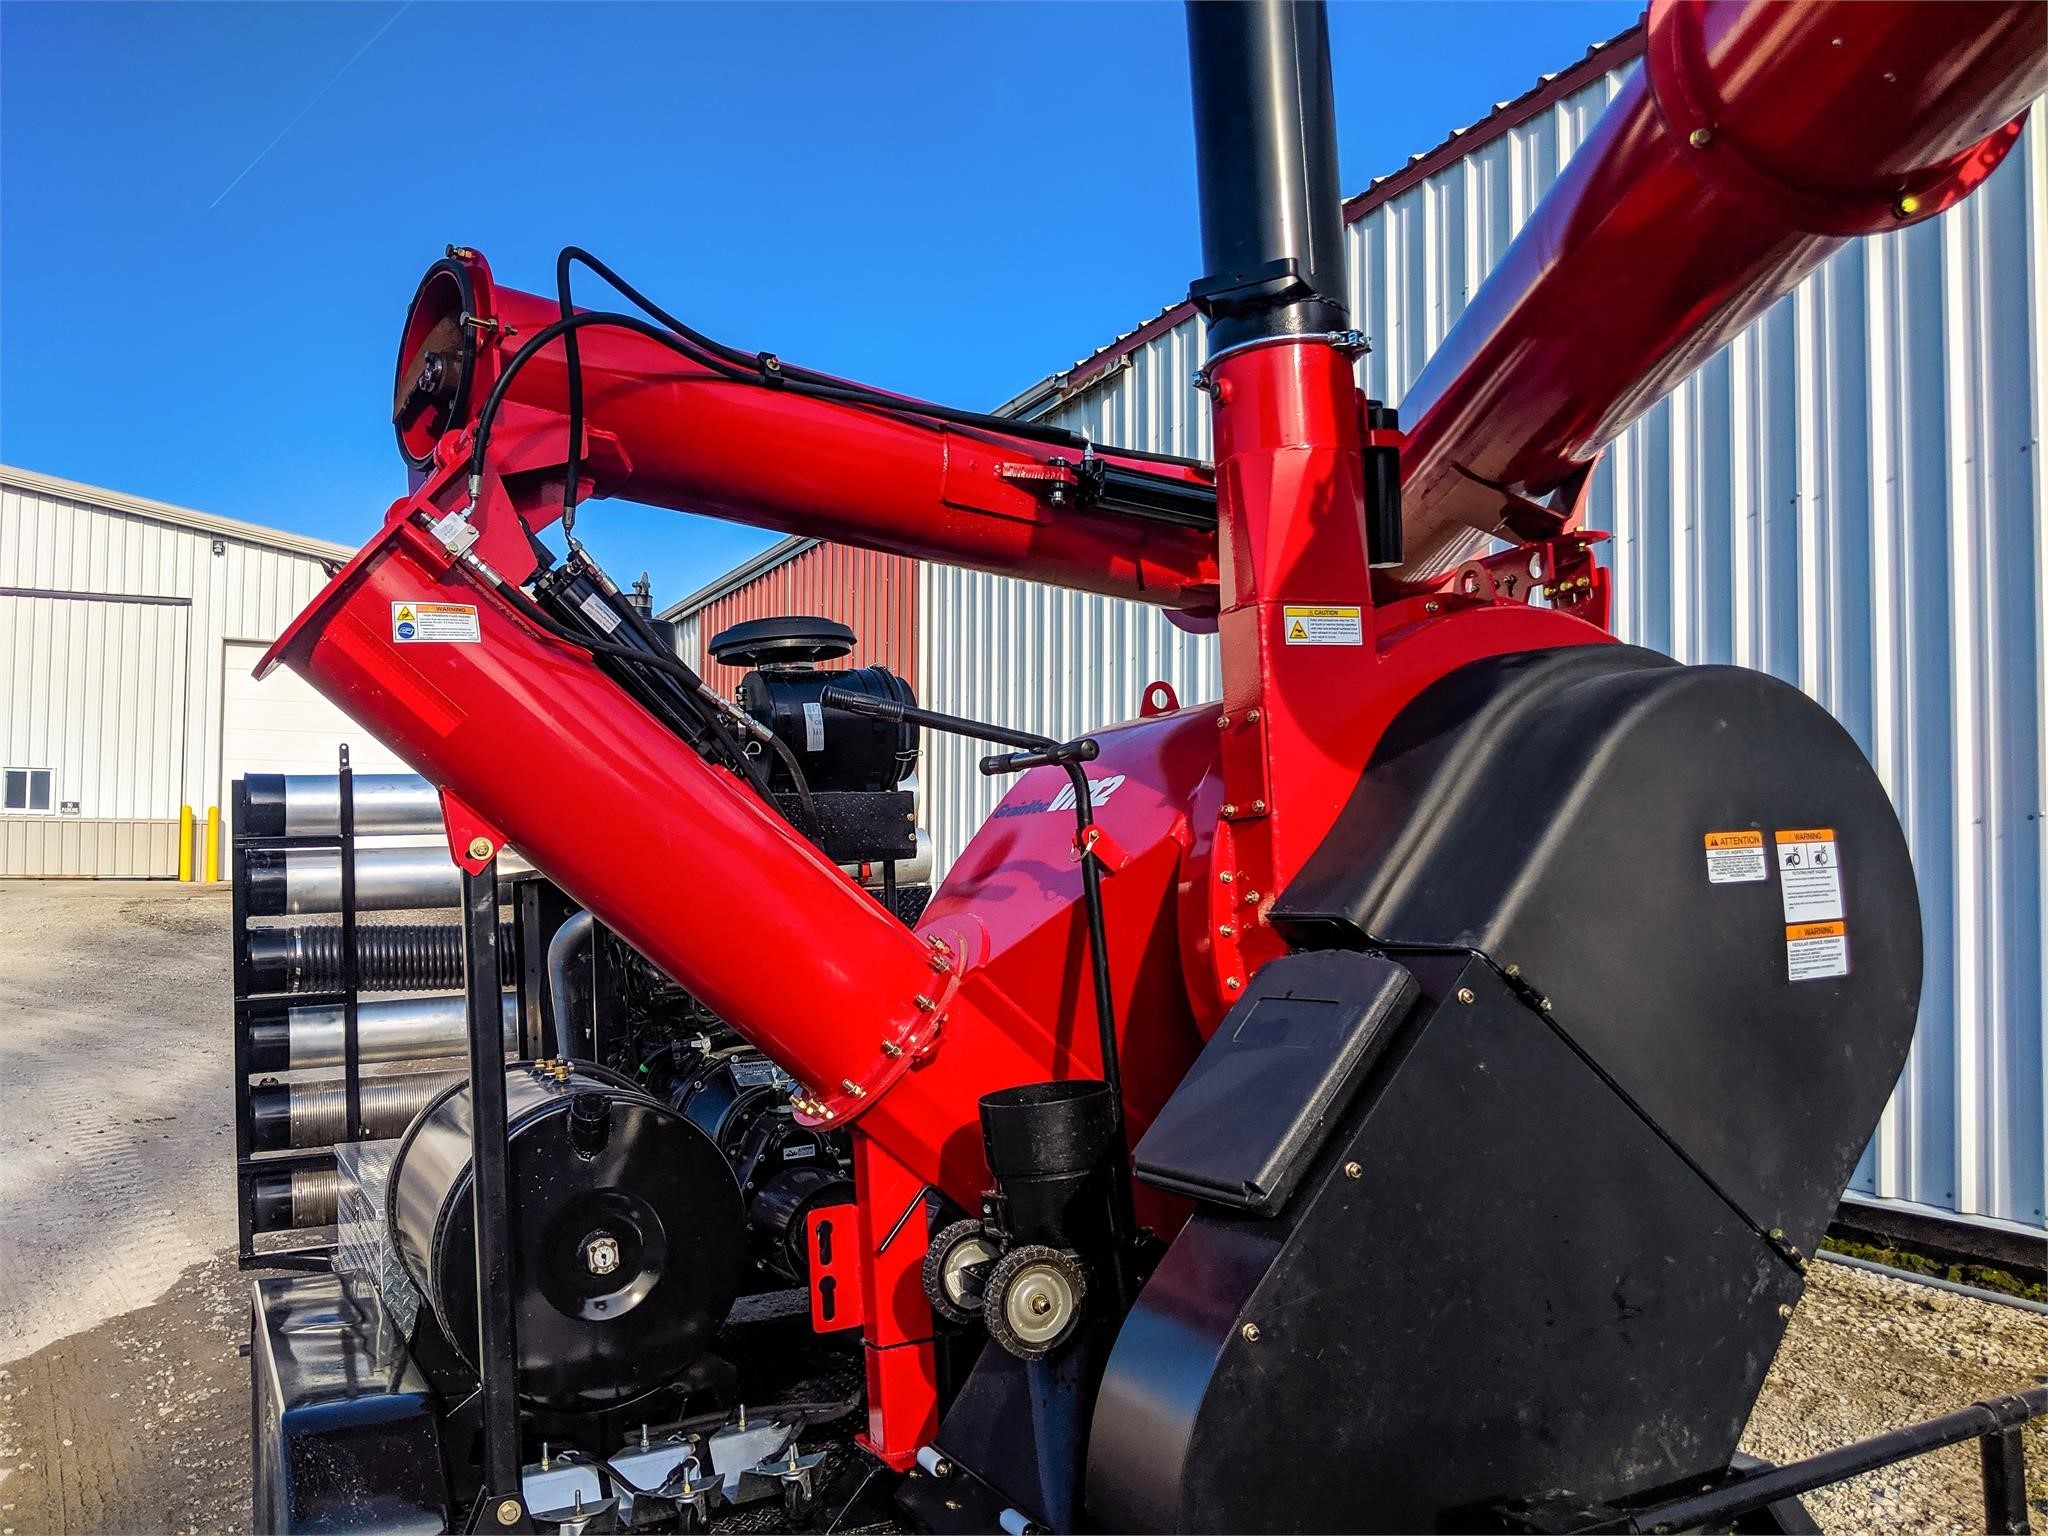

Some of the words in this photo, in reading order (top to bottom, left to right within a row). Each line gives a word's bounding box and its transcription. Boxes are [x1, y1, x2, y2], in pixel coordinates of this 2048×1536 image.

[1720, 835, 1760, 846] ATTENTION
[1793, 832, 1822, 841] WARNING
[1804, 926, 1834, 936] WARNING
